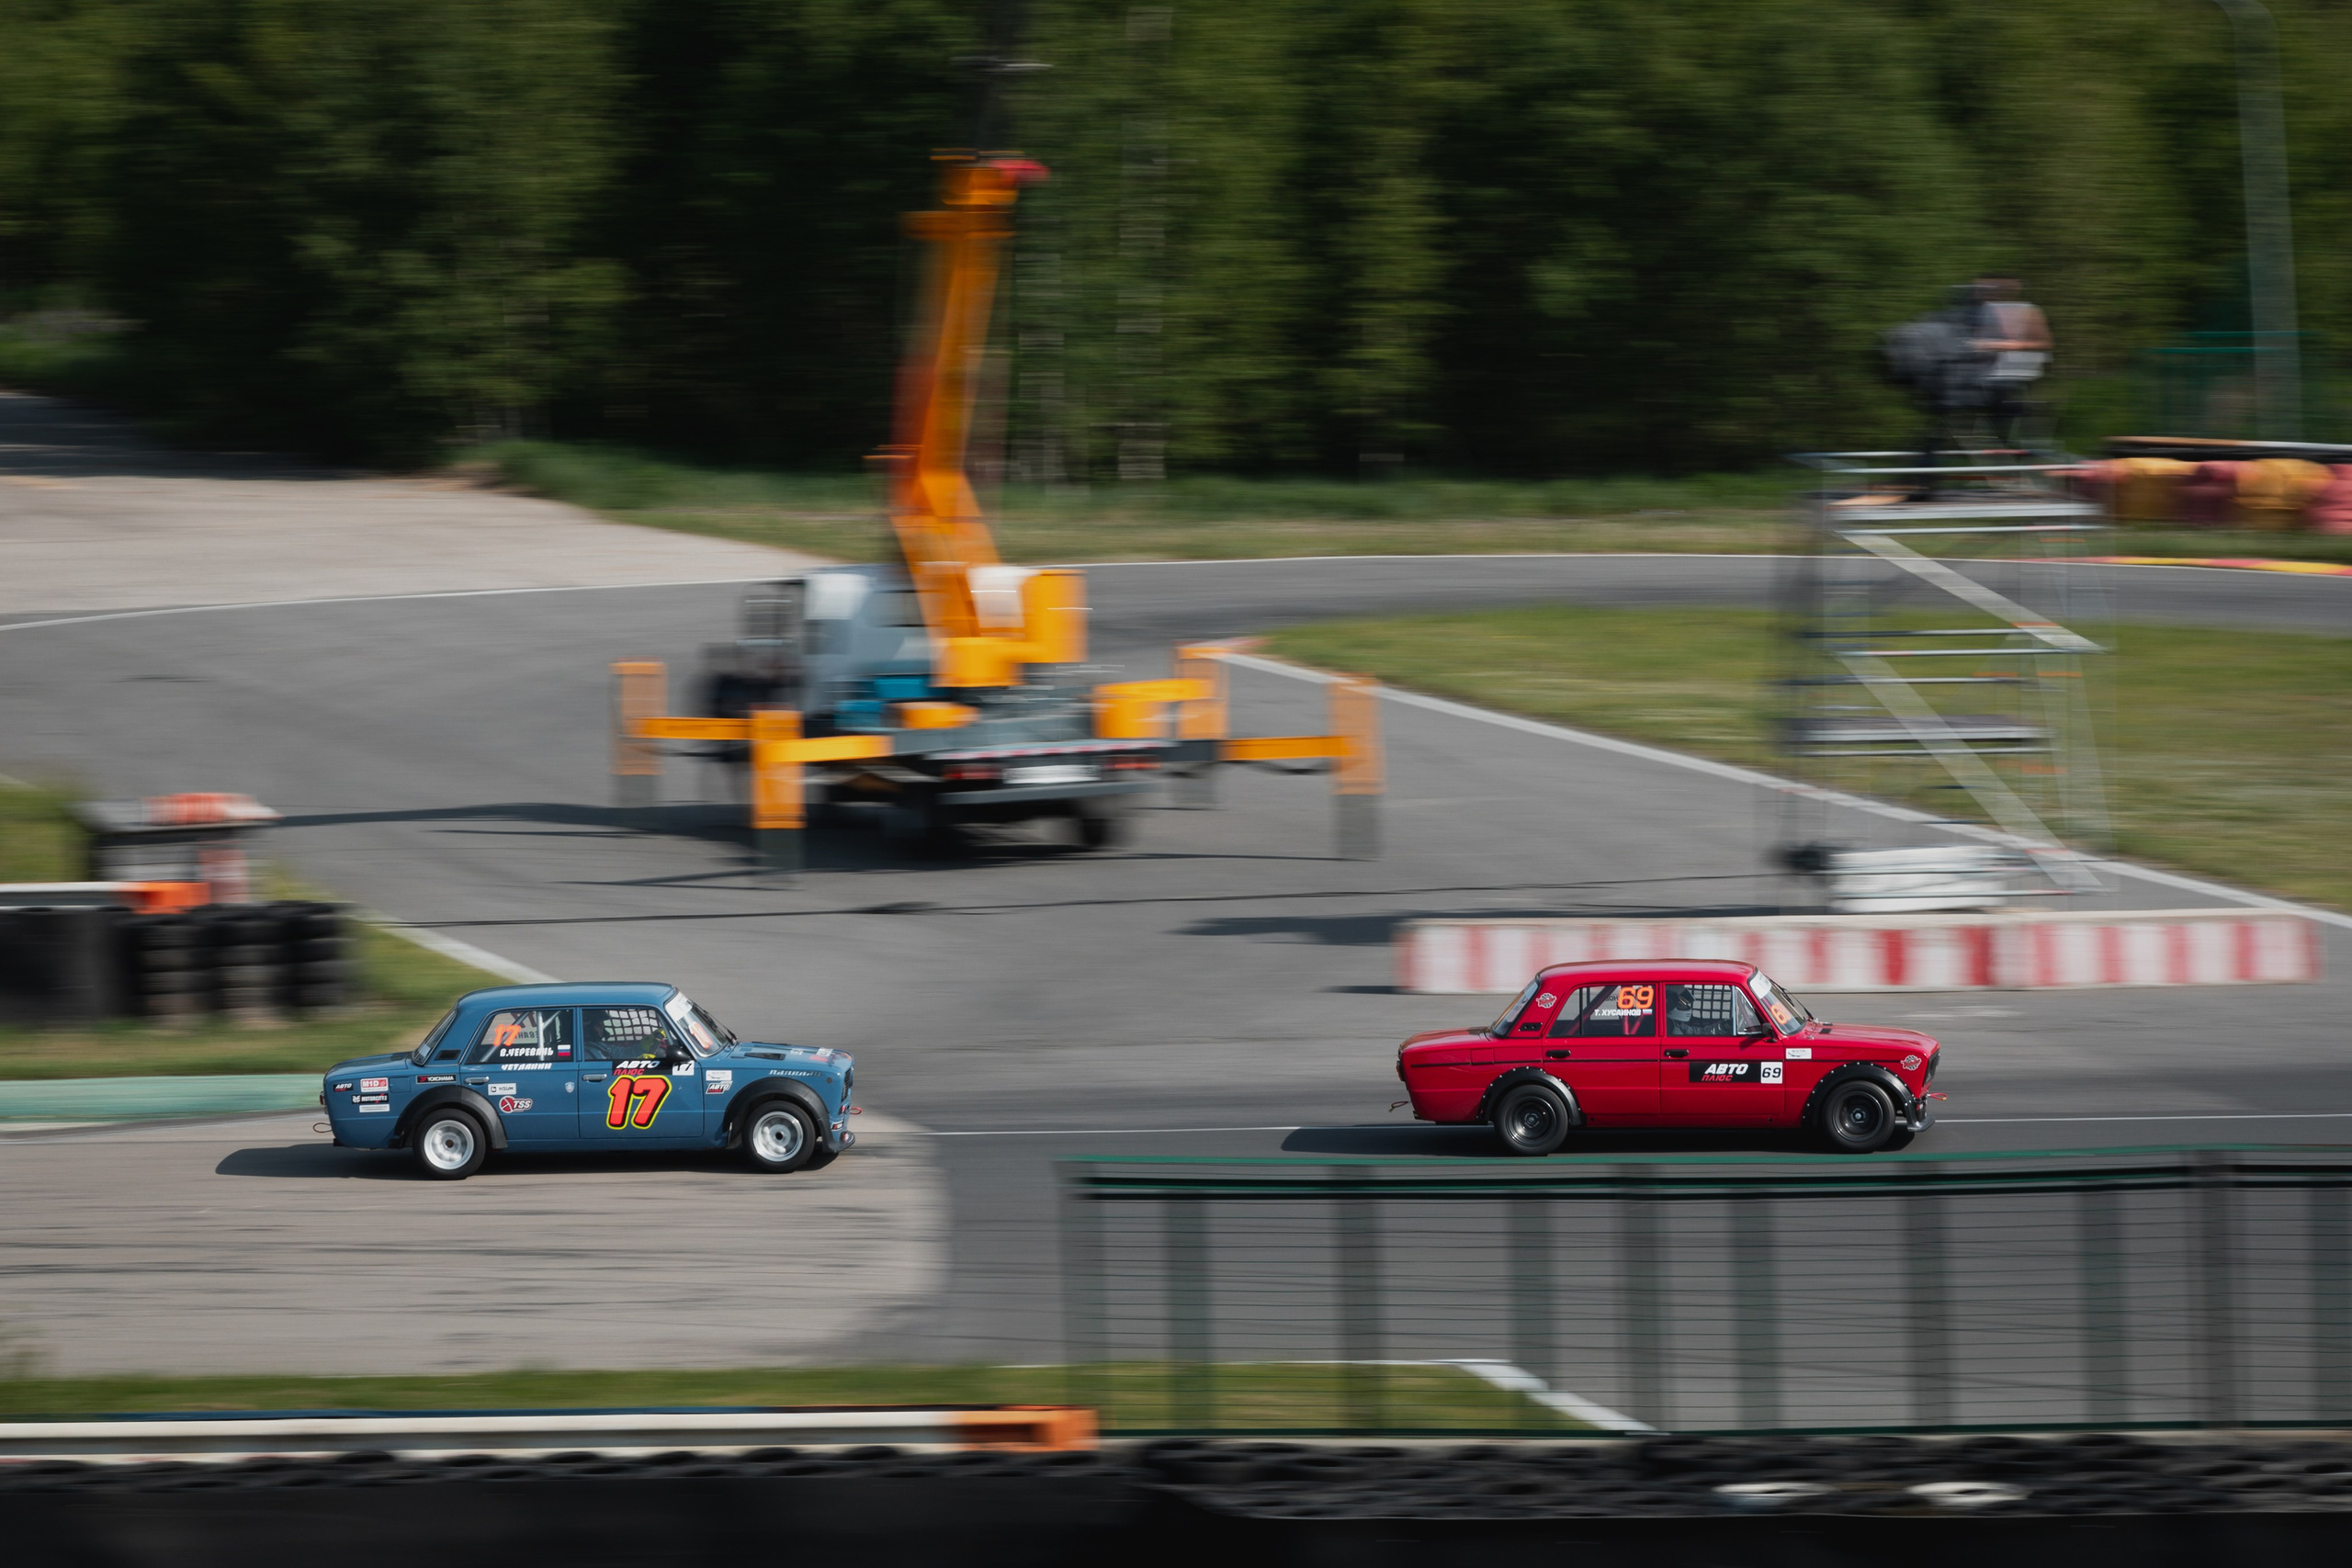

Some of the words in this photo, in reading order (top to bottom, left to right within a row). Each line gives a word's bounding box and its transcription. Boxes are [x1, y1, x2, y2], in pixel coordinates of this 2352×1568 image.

[1618, 987, 1654, 1009] 69
[493, 1024, 521, 1046] 17
[616, 1060, 661, 1068] АВТО
[1704, 1064, 1749, 1075] АВТО
[1762, 1067, 1781, 1078] 69
[513, 1100, 531, 1109] TSS
[606, 1075, 673, 1130] 17
